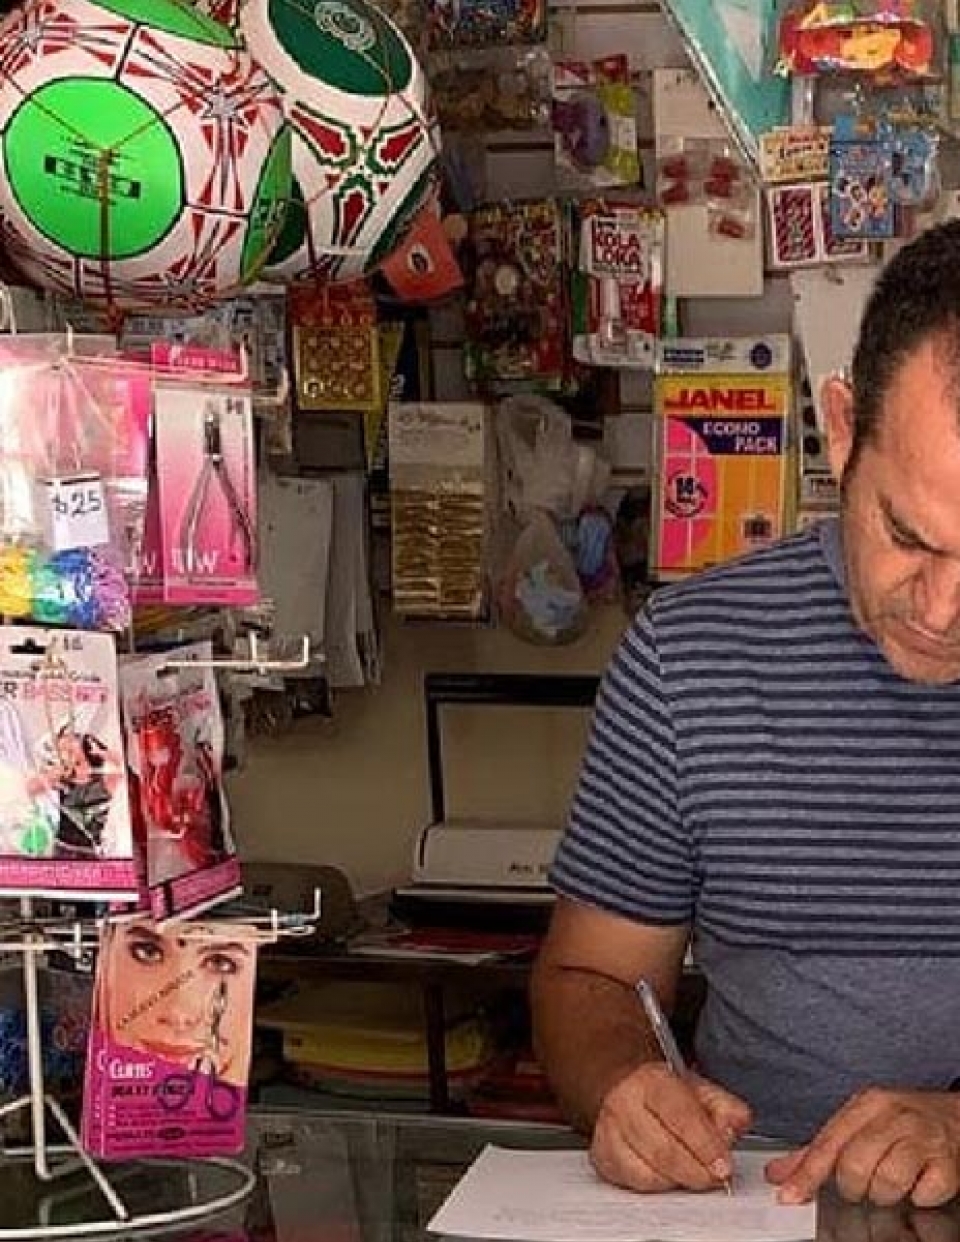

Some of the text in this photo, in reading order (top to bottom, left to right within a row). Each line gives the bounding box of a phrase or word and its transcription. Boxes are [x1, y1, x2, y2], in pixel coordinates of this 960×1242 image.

[663, 388, 777, 411] JANEL
[703, 421, 760, 436] ECONO
[735, 436, 777, 452] PACK
